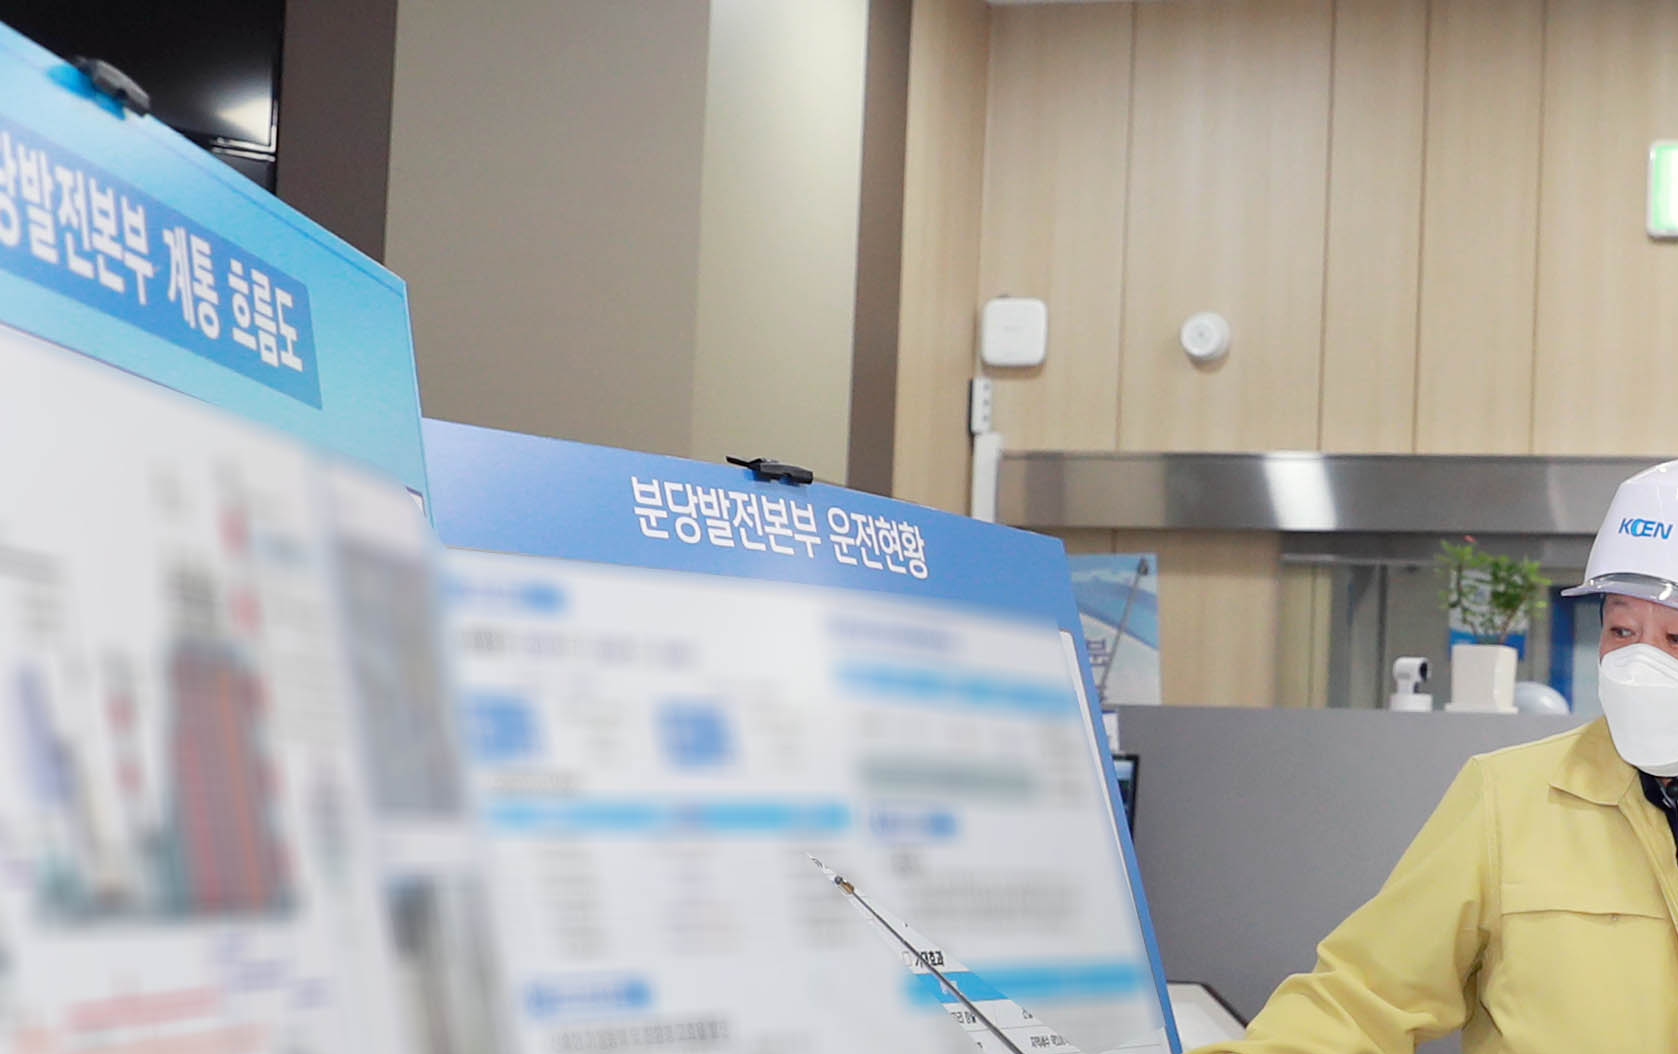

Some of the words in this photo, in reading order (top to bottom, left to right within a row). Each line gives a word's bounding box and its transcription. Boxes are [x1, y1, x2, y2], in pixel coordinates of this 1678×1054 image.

[162, 226, 221, 341] 계통
[227, 258, 304, 373] 흐름도
[631, 476, 822, 558] 분당발전본부
[827, 507, 929, 579] 운전현황
[1618, 518, 1674, 539] KOEN
